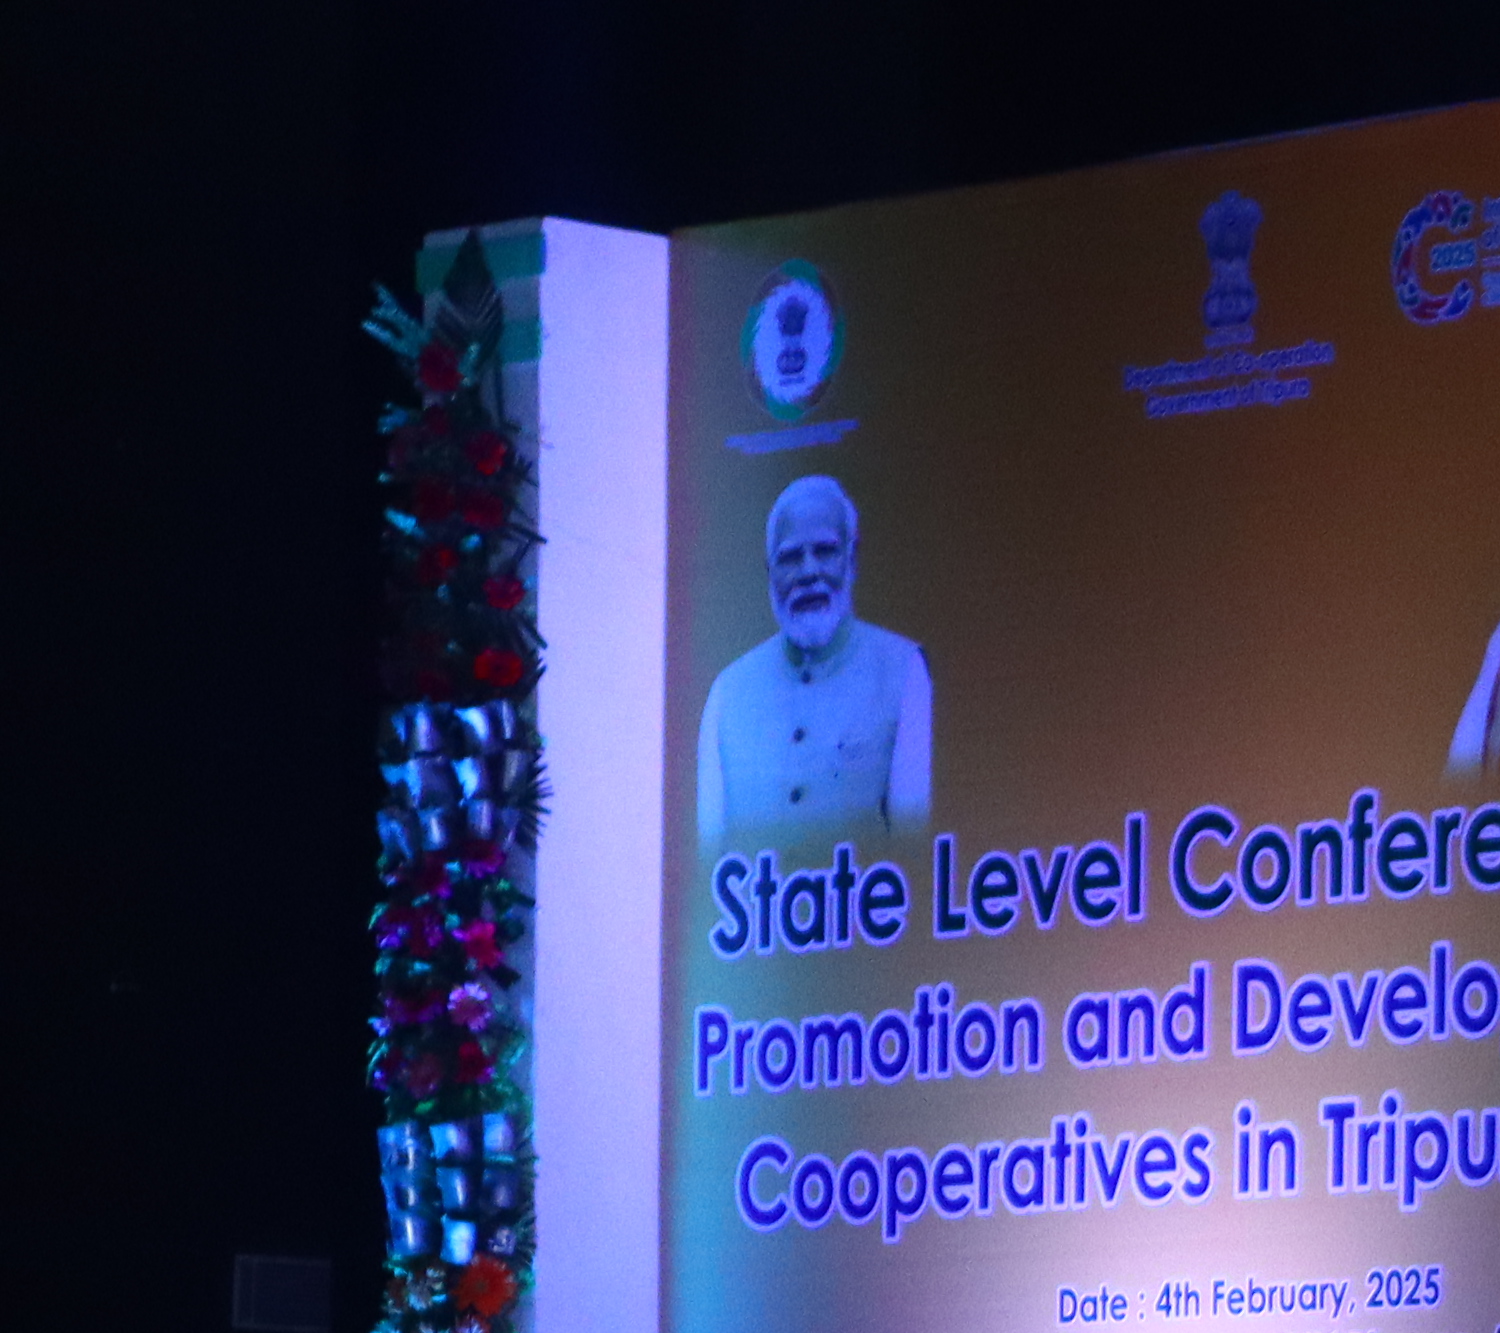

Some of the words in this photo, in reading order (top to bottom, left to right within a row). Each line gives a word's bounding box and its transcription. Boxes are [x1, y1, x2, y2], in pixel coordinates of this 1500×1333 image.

[1431, 242, 1475, 270] 2025
[710, 845, 906, 956] State
[935, 814, 1145, 935] Level
[698, 987, 1041, 1092] Promotion
[1066, 966, 1206, 1064] and
[739, 1116, 1212, 1240] Cooperatives
[1236, 1105, 1297, 1193] in
[1058, 1286, 1128, 1324] Date
[1154, 1280, 1200, 1318] 4th
[1212, 1278, 1356, 1319] February,
[1366, 1267, 1441, 1308] 2025
